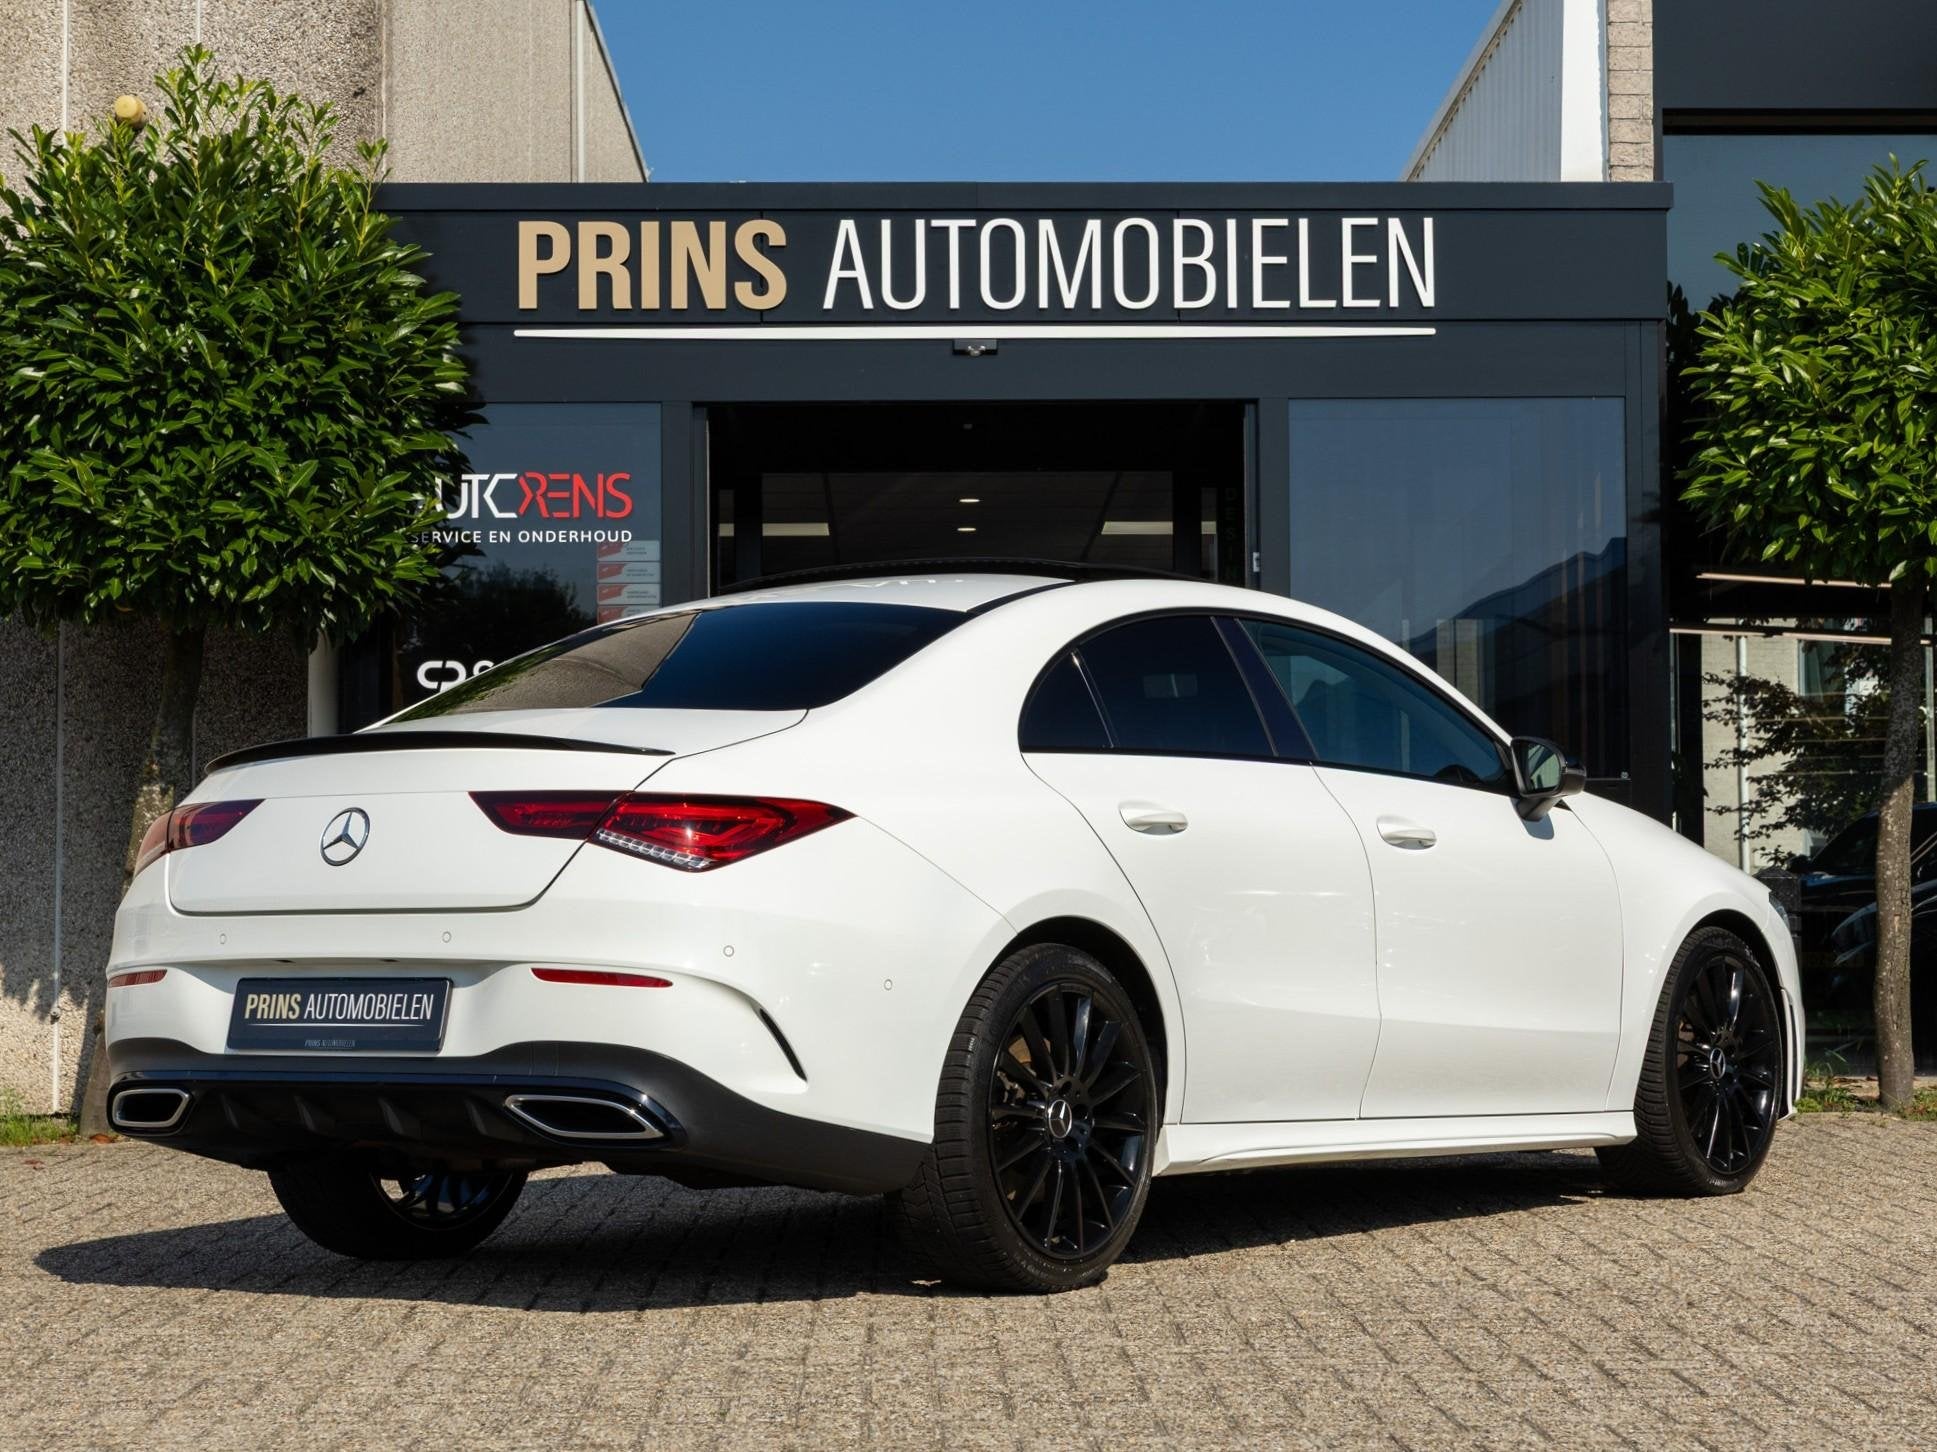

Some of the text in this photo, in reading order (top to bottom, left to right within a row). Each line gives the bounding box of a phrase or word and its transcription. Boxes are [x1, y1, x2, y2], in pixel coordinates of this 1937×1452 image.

[518, 217, 1436, 310] PRINS AUTOMOBIELEN
[489, 531, 511, 543] EN
[518, 530, 633, 543] ONDERHOUD
[244, 993, 434, 1020] PRINS AUTOMOBIELEN
